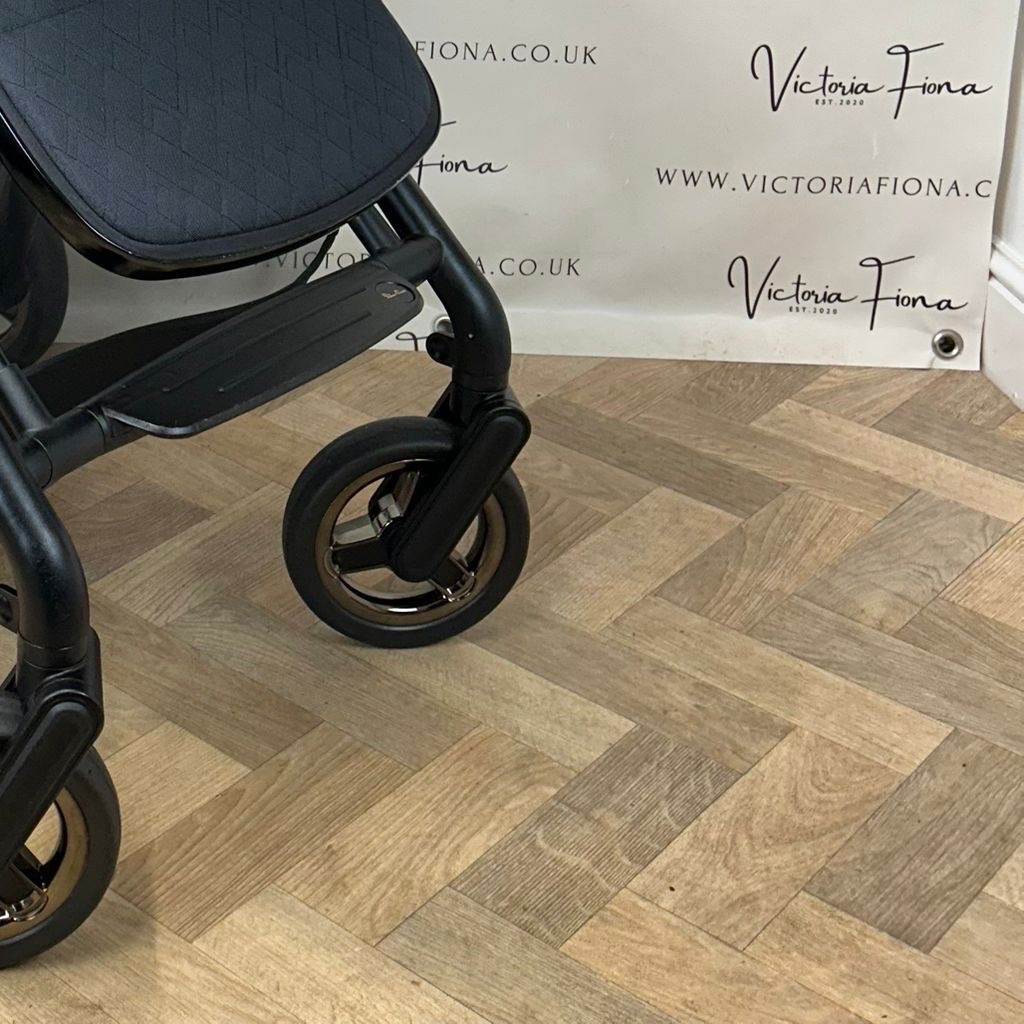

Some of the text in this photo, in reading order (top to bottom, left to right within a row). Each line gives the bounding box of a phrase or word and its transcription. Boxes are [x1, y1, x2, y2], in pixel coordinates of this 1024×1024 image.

[751, 42, 994, 120] Victoria Fiona
[728, 255, 968, 331] Victoria Fiona
